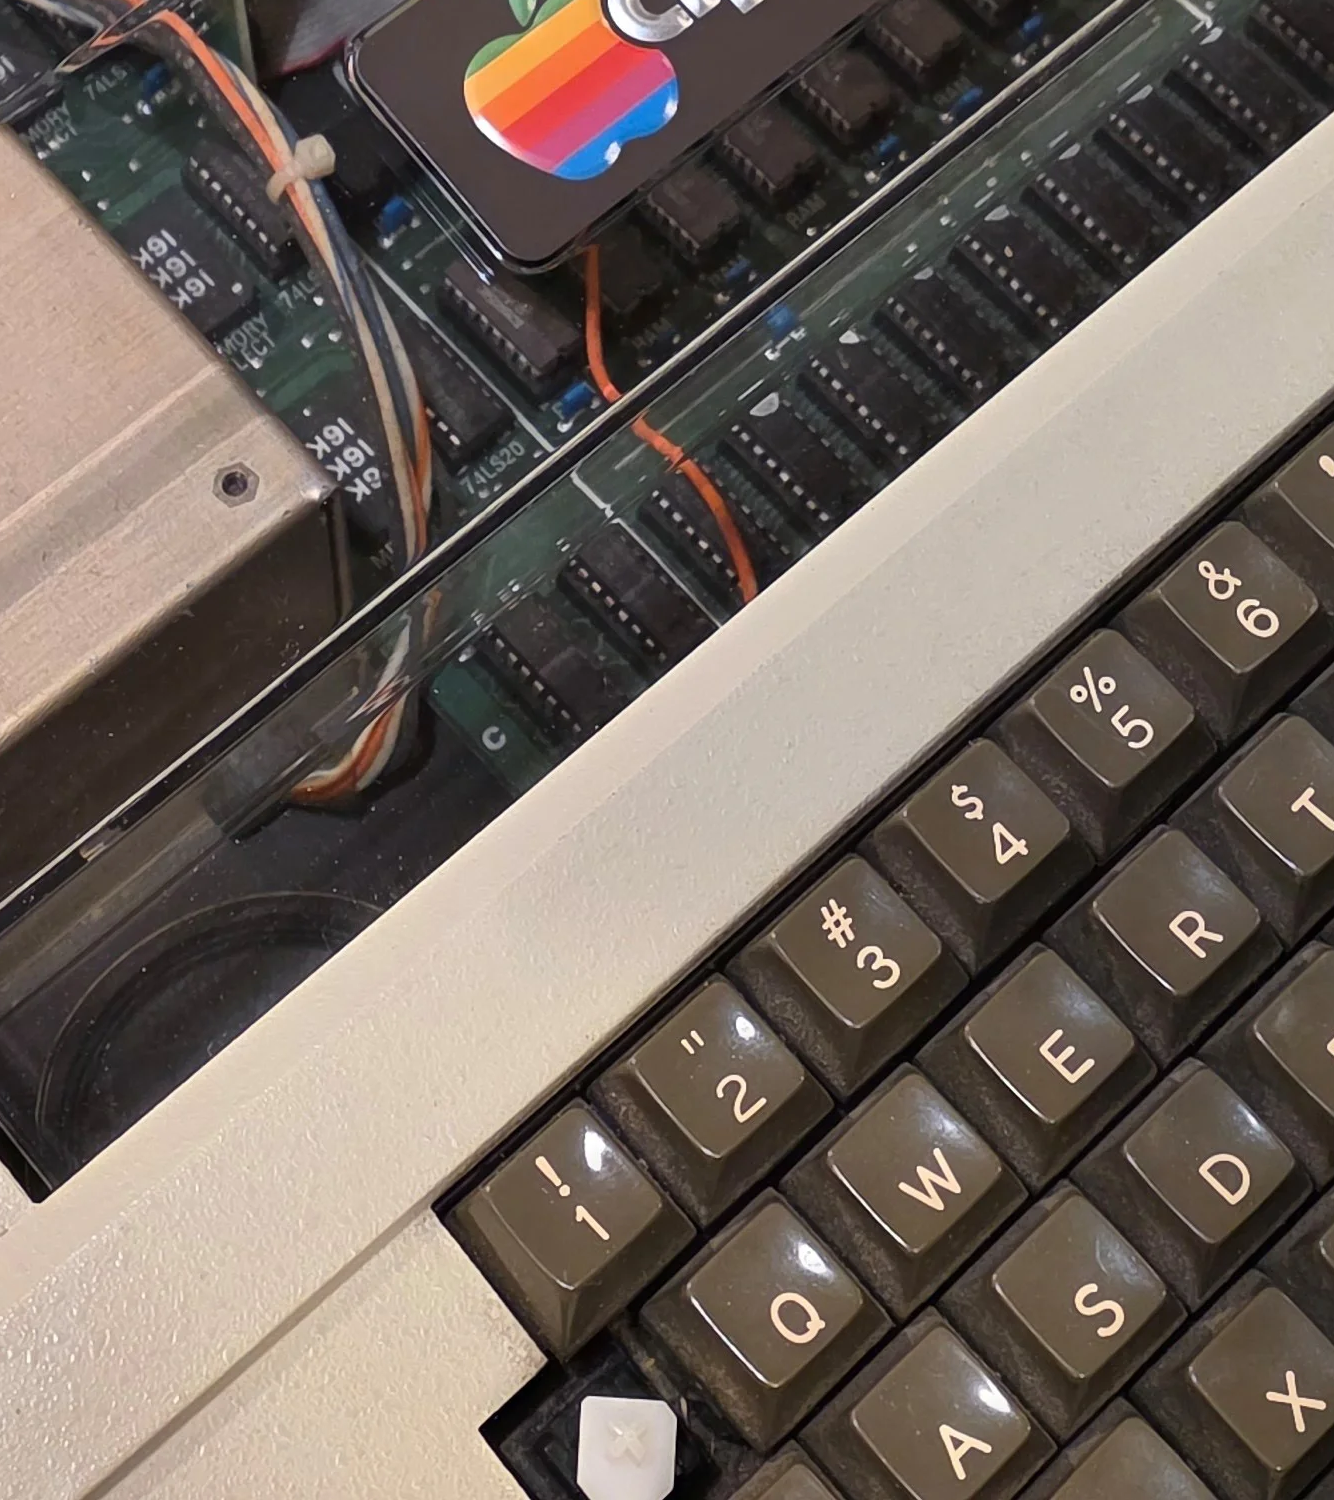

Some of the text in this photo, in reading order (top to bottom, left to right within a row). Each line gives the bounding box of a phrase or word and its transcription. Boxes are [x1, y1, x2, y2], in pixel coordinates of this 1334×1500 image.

[131, 228, 178, 270] 16K
[149, 250, 197, 288] 16K
[169, 269, 216, 309] 16K
[305, 417, 355, 460] 16K
[325, 438, 375, 481] 16K
[1199, 560, 1241, 600] &
[1236, 599, 1279, 638] 6
[1070, 666, 1116, 713] %
[1111, 704, 1154, 749] 5
[951, 784, 983, 820] $
[992, 821, 1028, 864] 4
[820, 898, 855, 948] #
[1168, 910, 1224, 959] R
[857, 945, 900, 989] 3
[1039, 1029, 1095, 1084] E
[716, 1074, 766, 1123] 2
[535, 1155, 570, 1198] !
[898, 1147, 962, 1211] W
[1199, 1153, 1251, 1205] D
[575, 1205, 609, 1241] 1
[770, 1292, 825, 1344] Q
[1074, 1282, 1125, 1338] S
[1266, 1369, 1327, 1433] X
[939, 1423, 992, 1480] A
